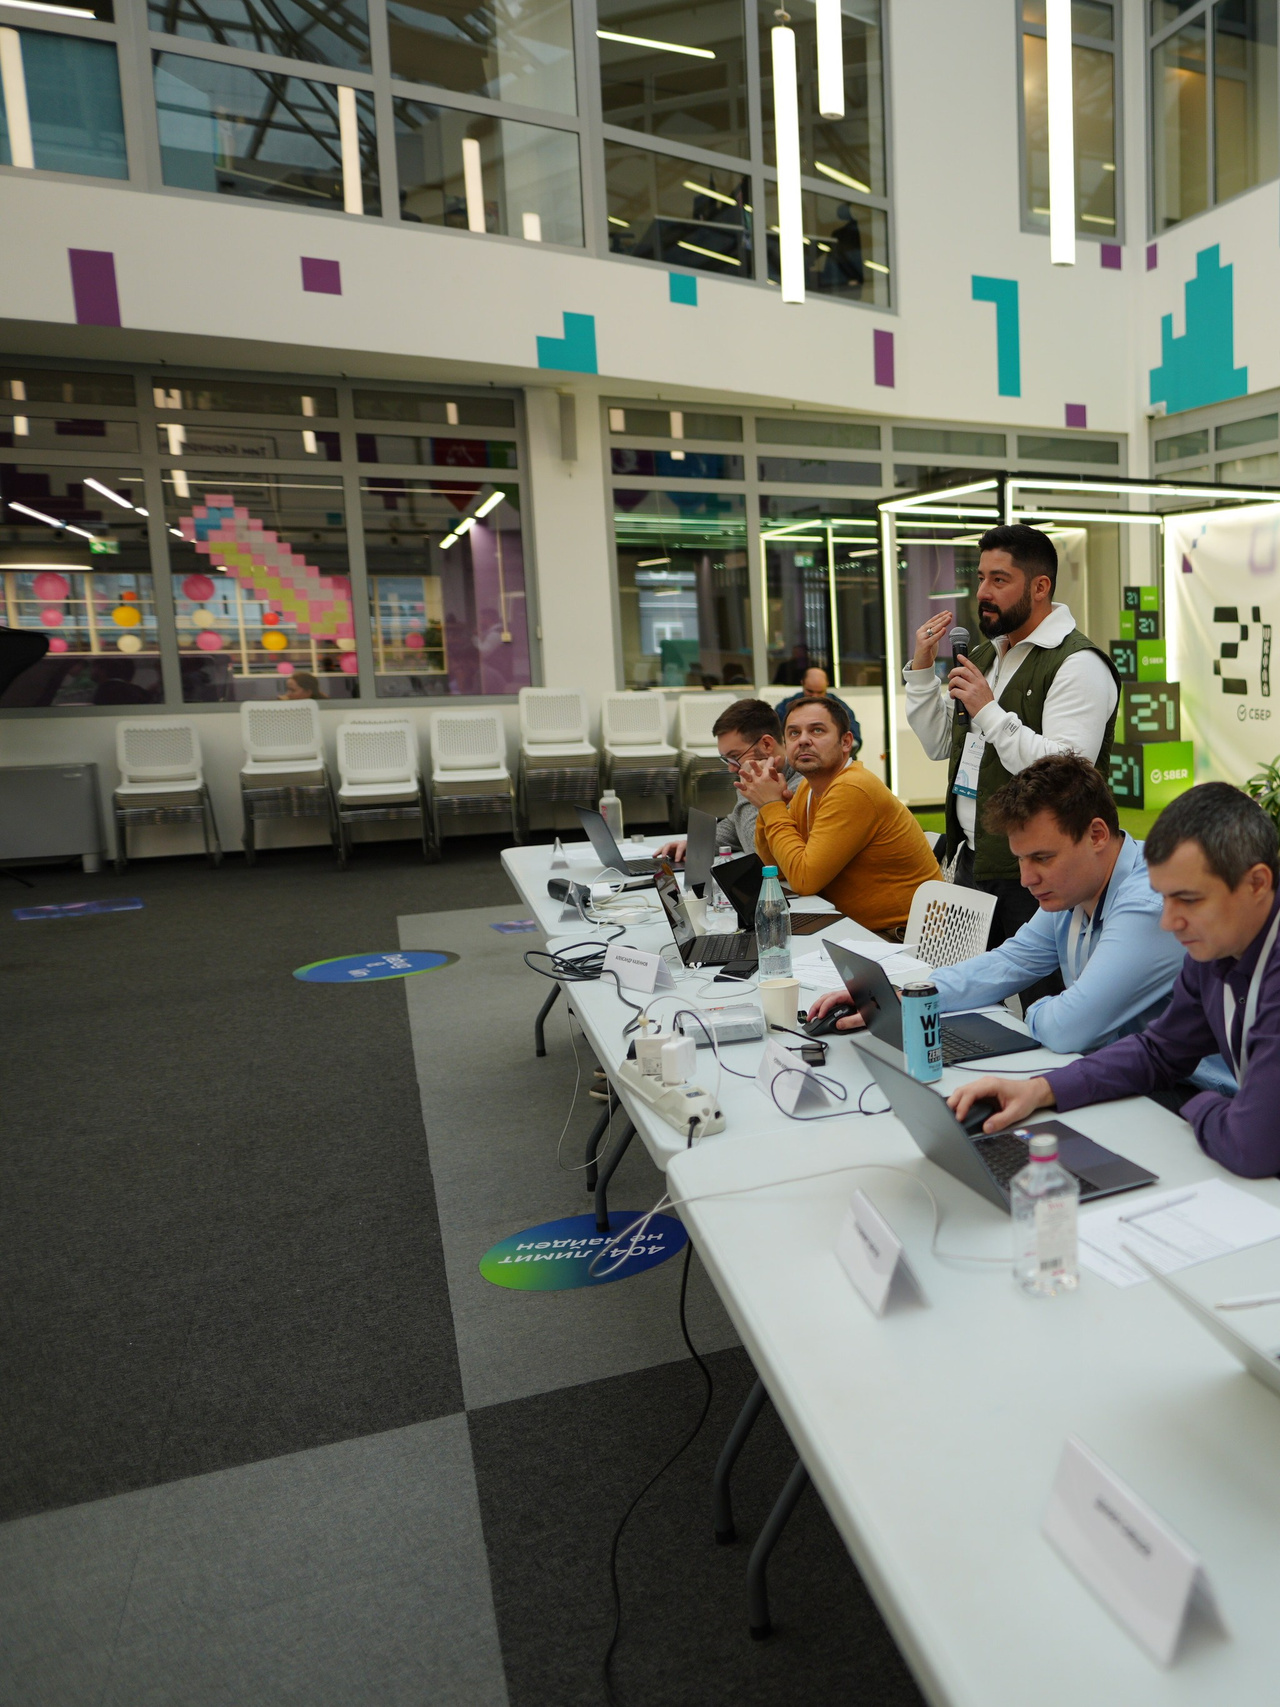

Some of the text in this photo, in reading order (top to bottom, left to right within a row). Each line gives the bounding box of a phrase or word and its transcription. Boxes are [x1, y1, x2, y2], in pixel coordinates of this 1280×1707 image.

[1126, 591, 1138, 605] 21
[1139, 617, 1155, 633] 21
[1113, 648, 1135, 674] 21
[1130, 693, 1175, 731] 21
[1249, 708, 1271, 720] СБЕР
[1108, 754, 1140, 797] 21
[1163, 768, 1188, 780] SBER
[516, 1232, 664, 1251] не найден
[498, 1250, 594, 1264] лимит
